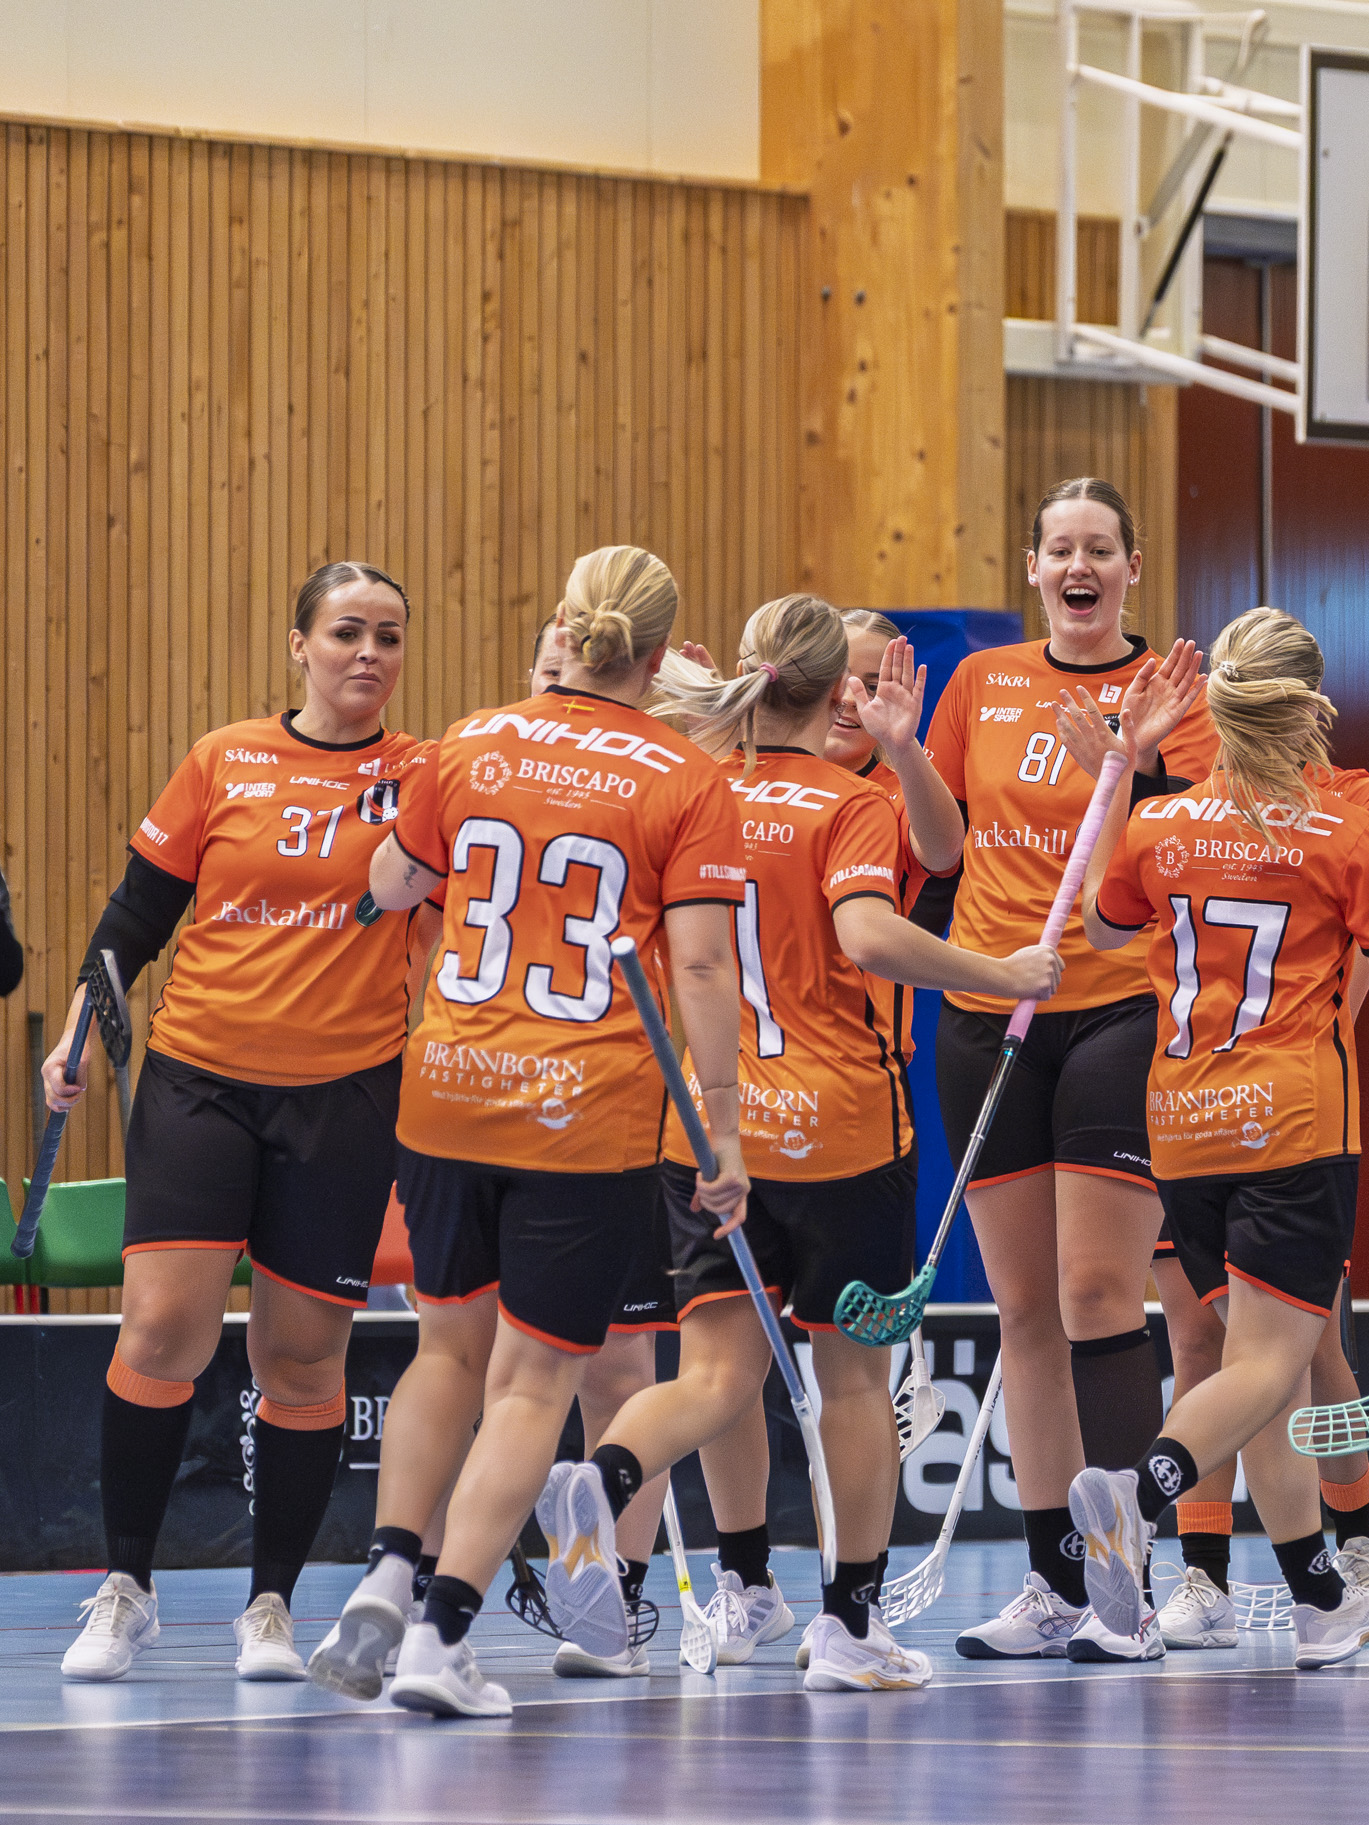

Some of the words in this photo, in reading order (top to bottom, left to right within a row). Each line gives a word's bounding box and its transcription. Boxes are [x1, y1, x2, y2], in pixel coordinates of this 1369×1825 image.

[985, 673, 1030, 688] SÄKRA
[993, 714, 1021, 723] SPORT
[996, 707, 1023, 716] INTER
[459, 713, 685, 773] UNIHOC
[225, 748, 278, 765] SÄKRA
[245, 783, 276, 791] INTER
[290, 776, 350, 791] UNIHOC
[515, 758, 637, 799] BRISCAPO
[244, 789, 274, 798] SPORT
[742, 819, 794, 844] CAPO
[972, 822, 1067, 855] ackahill
[1193, 839, 1304, 867] BRISCAPO
[212, 900, 348, 930] Jackahill
[436, 815, 629, 1022] 33
[734, 879, 784, 1060] 1
[1164, 893, 1291, 1060] 17
[420, 1066, 583, 1097] FASTIGHETER
[1150, 1082, 1273, 1112] BRÄNNBORN
[1151, 1106, 1274, 1126] FASTIGHETER
[1113, 1150, 1151, 1167] UNIHO
